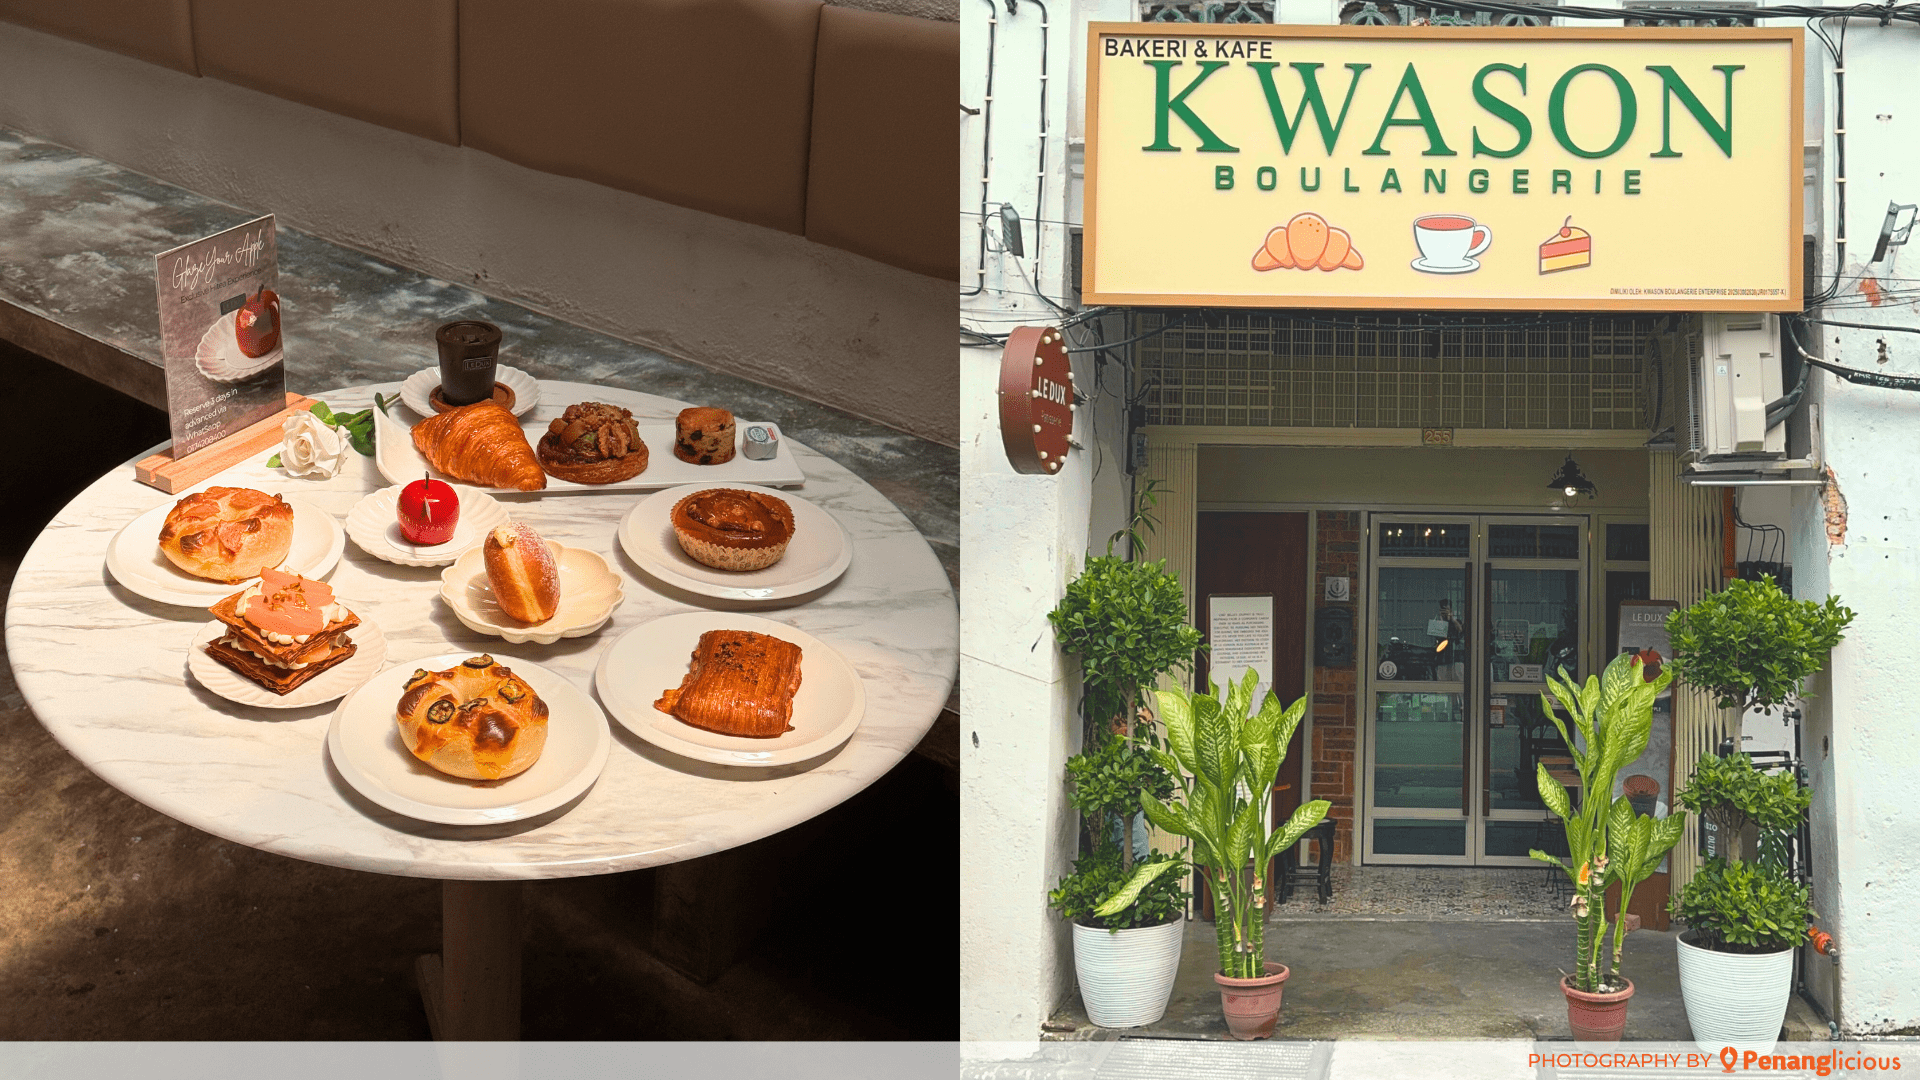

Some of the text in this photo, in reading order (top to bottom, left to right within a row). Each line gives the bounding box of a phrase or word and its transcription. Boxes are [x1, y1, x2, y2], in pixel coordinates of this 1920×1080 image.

[1105, 38, 1273, 59] BAKERI & KAFE
[1142, 60, 1746, 159] KWASON
[1215, 165, 1642, 194] BOULANGERIE
[184, 401, 210, 416] Reserve
[215, 391, 231, 403] days
[230, 388, 238, 397] in
[1038, 376, 1066, 406] LE DUX
[185, 405, 227, 429] advanced via
[1424, 430, 1451, 444] 255
[1632, 613, 1663, 622] LE DUX
